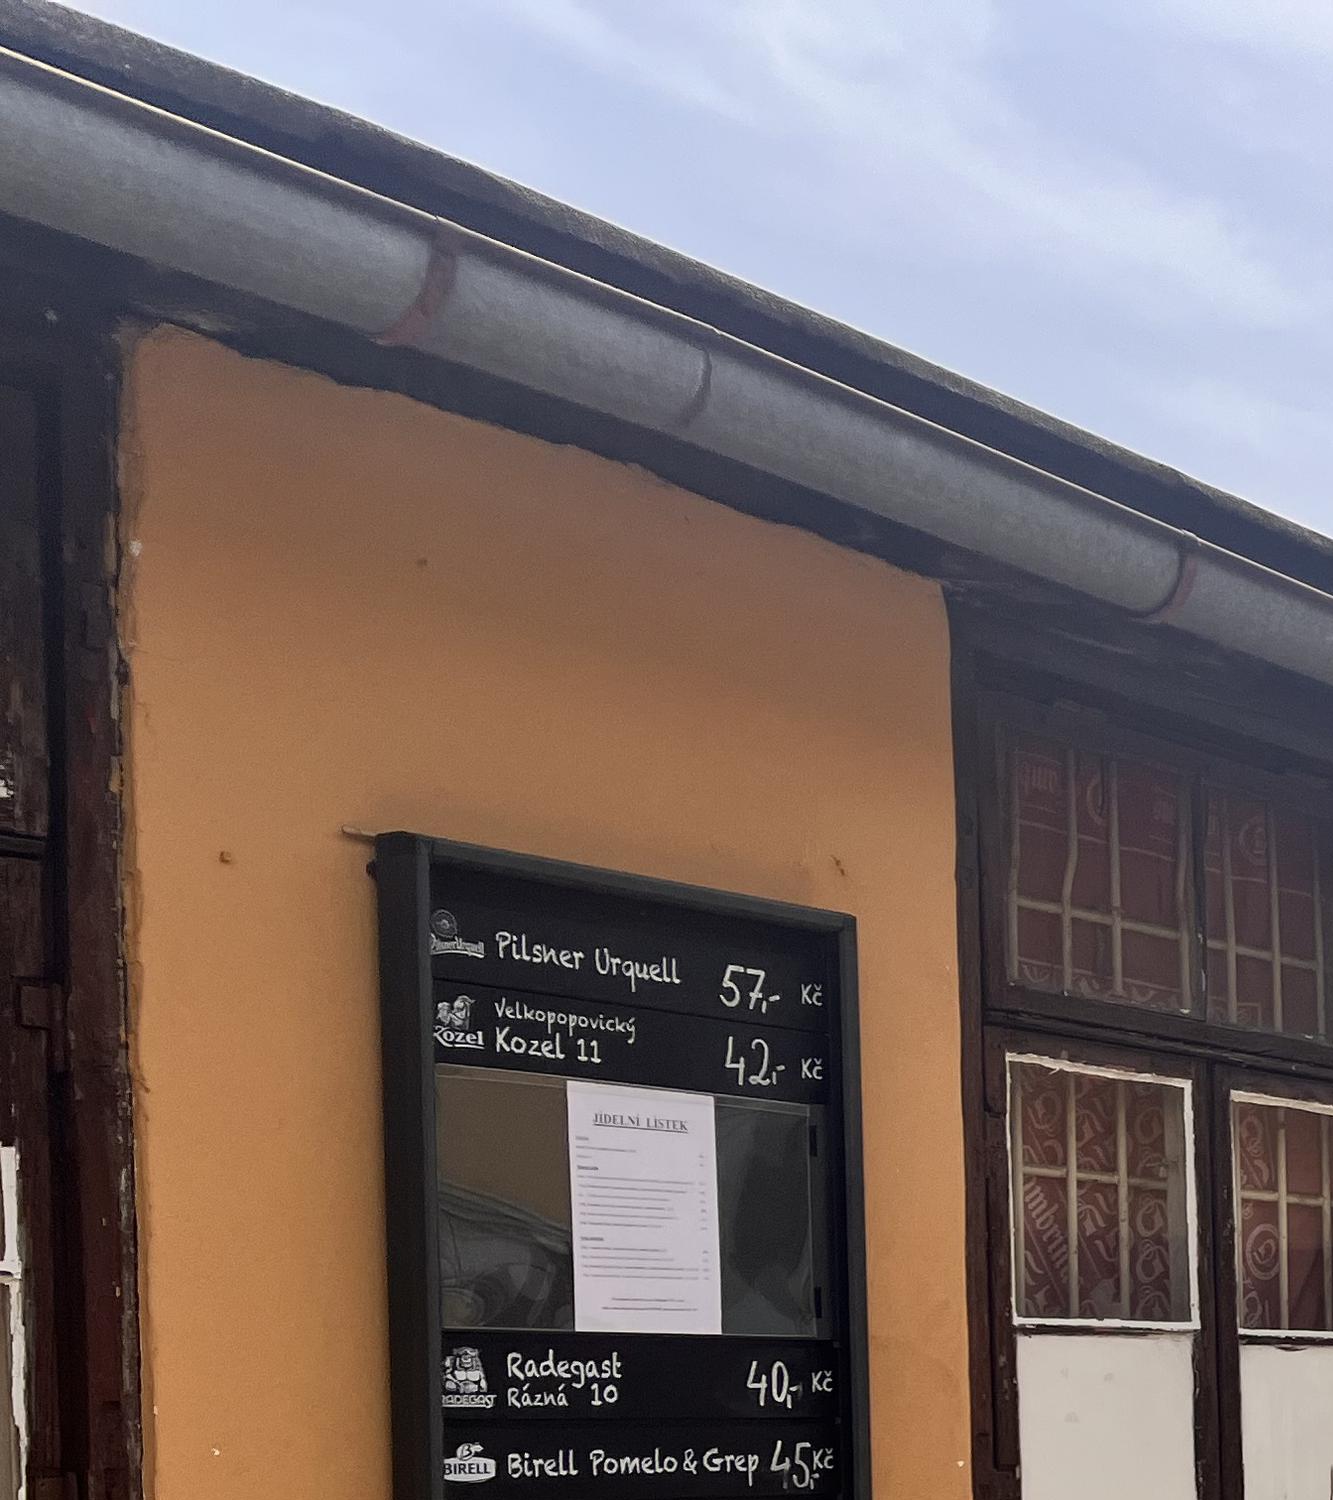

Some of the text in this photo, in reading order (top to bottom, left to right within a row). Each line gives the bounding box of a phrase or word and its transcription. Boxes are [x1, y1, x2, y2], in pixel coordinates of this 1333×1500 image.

[494, 931, 823, 1014] Pilsner Urquell 57,- Kč
[494, 997, 636, 1044] Velkopopovický
[495, 1027, 823, 1086] Kozel 11 42,- Kč
[592, 1109, 641, 1127] JÍDELNÍ
[507, 1349, 622, 1388] Radegast
[507, 1382, 569, 1408] Rázná
[590, 1383, 618, 1406] 10
[812, 1370, 833, 1392] Kč
[507, 1449, 579, 1478] Birell
[590, 1448, 678, 1477] Pomelo
[702, 1448, 759, 1487] Grep
[812, 1448, 834, 1471] Kč
